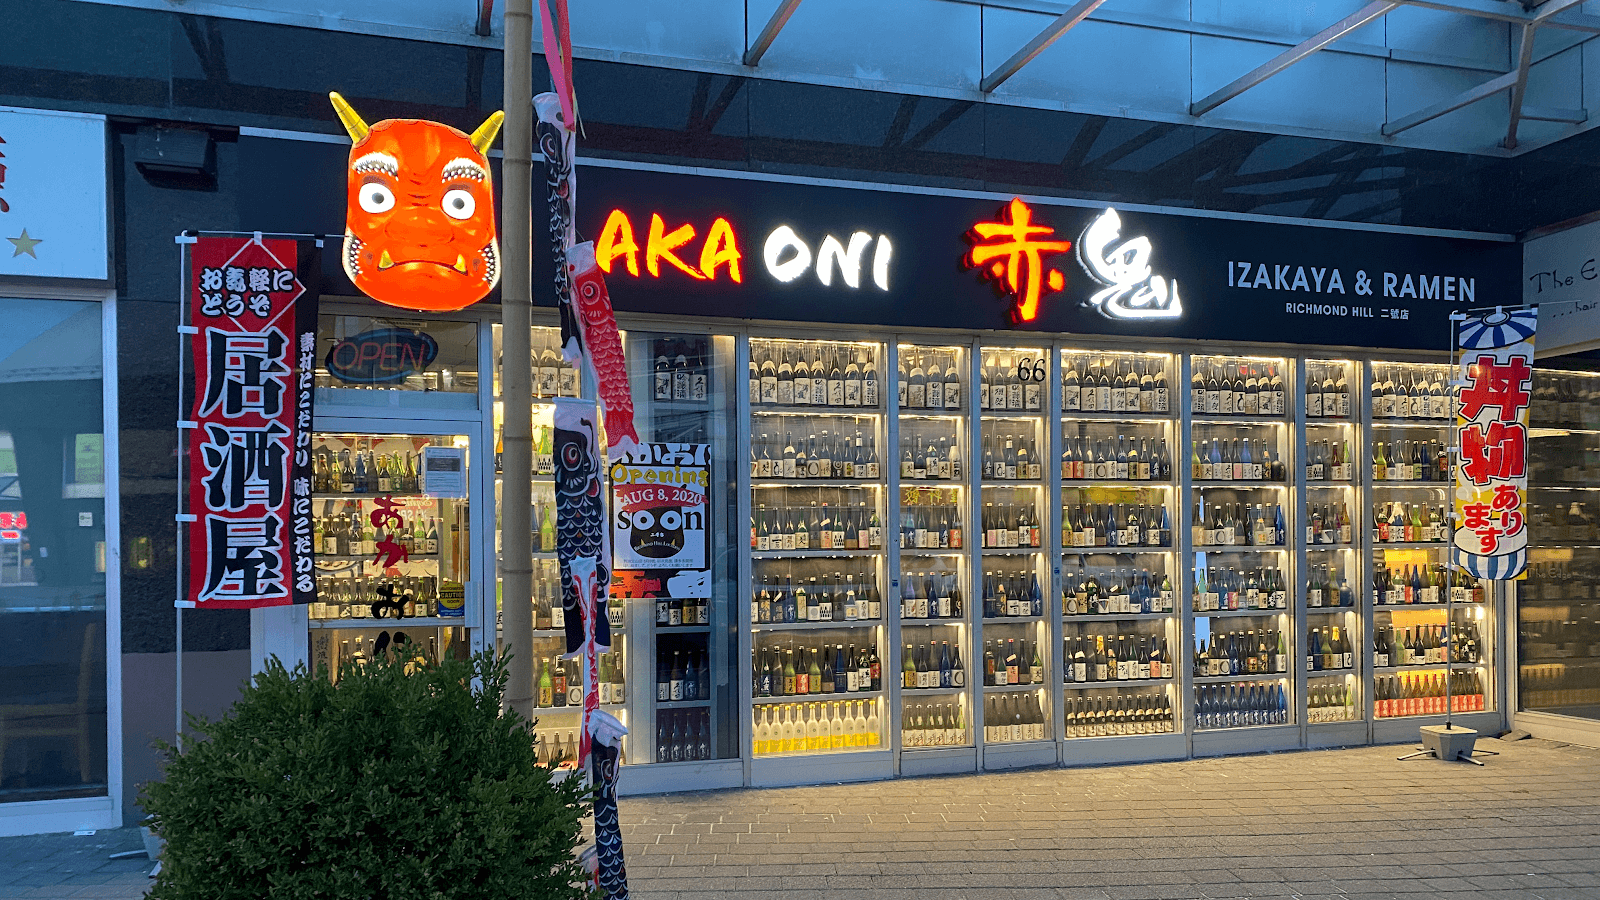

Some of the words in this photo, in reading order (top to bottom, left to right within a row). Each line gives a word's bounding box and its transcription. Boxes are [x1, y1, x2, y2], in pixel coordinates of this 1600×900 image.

[595, 208, 742, 284] AKA
[763, 225, 892, 291] ONI
[1228, 260, 1346, 295] IZAKAYA
[1355, 270, 1373, 296] &
[1383, 272, 1476, 302] RAMEN
[1529, 269, 1574, 293] The
[201, 293, 270, 317] どうぞ
[1285, 302, 1348, 318] RICHMOND
[1352, 304, 1374, 318] HILL
[333, 342, 425, 371] OPEN
[1017, 357, 1046, 382] 66
[297, 332, 315, 467] 素材にこだわり
[1458, 354, 1532, 485] 丼物
[197, 325, 292, 602] 居酒屋
[610, 463, 709, 487] Opening
[623, 488, 654, 505] AUG
[657, 488, 669, 502] 8,
[672, 489, 702, 504] 2020
[293, 478, 314, 593] 味にこだわる
